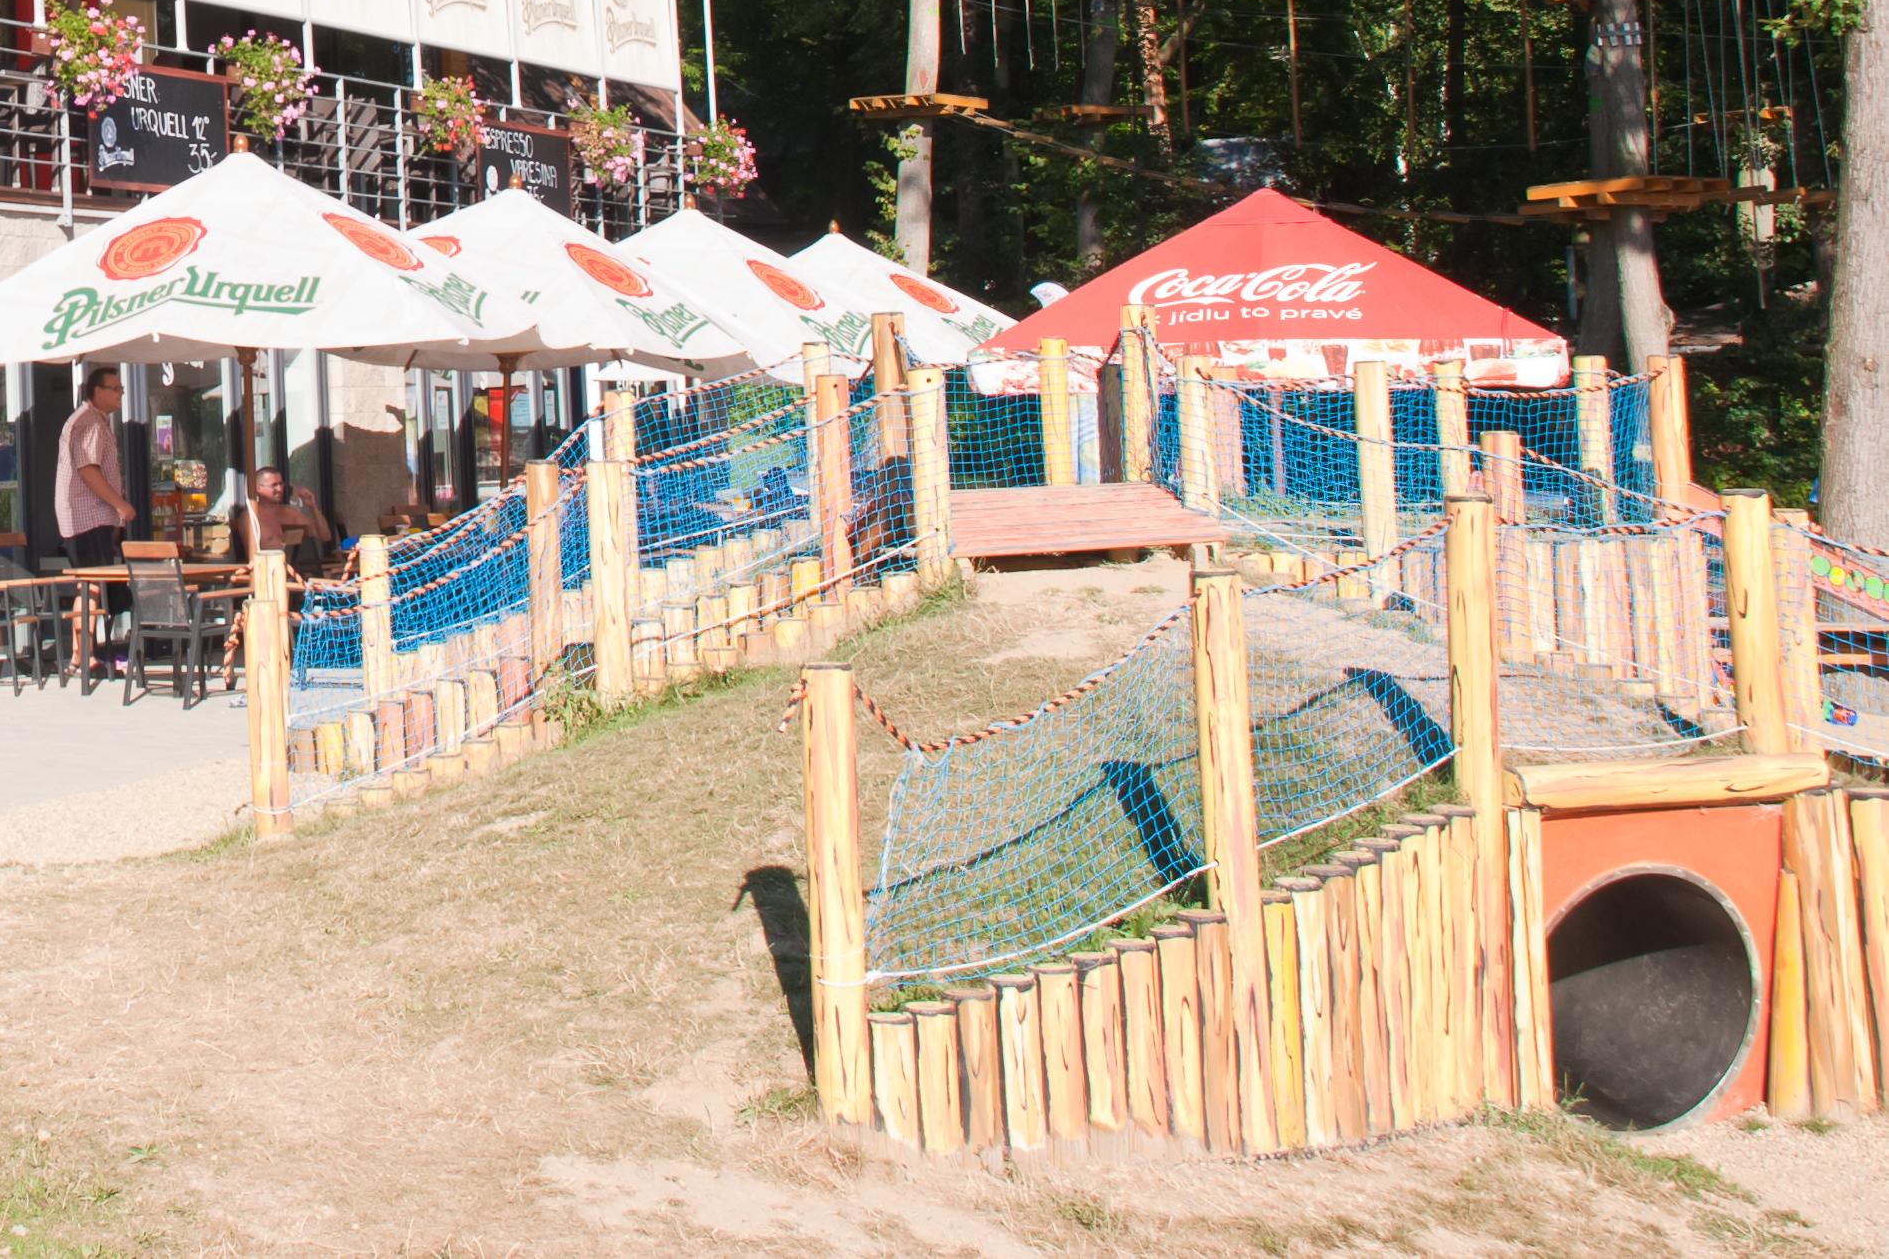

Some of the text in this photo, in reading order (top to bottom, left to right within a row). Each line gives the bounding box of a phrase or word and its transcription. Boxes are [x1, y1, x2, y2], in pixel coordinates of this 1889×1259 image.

[131, 106, 189, 140] URQUELL
[1128, 261, 1378, 308] Coca-Cola
[41, 265, 321, 350] Pilsner Urquell
[1168, 308, 1229, 326] jídlu
[1240, 306, 1270, 319] to
[1280, 307, 1364, 321] pravé
